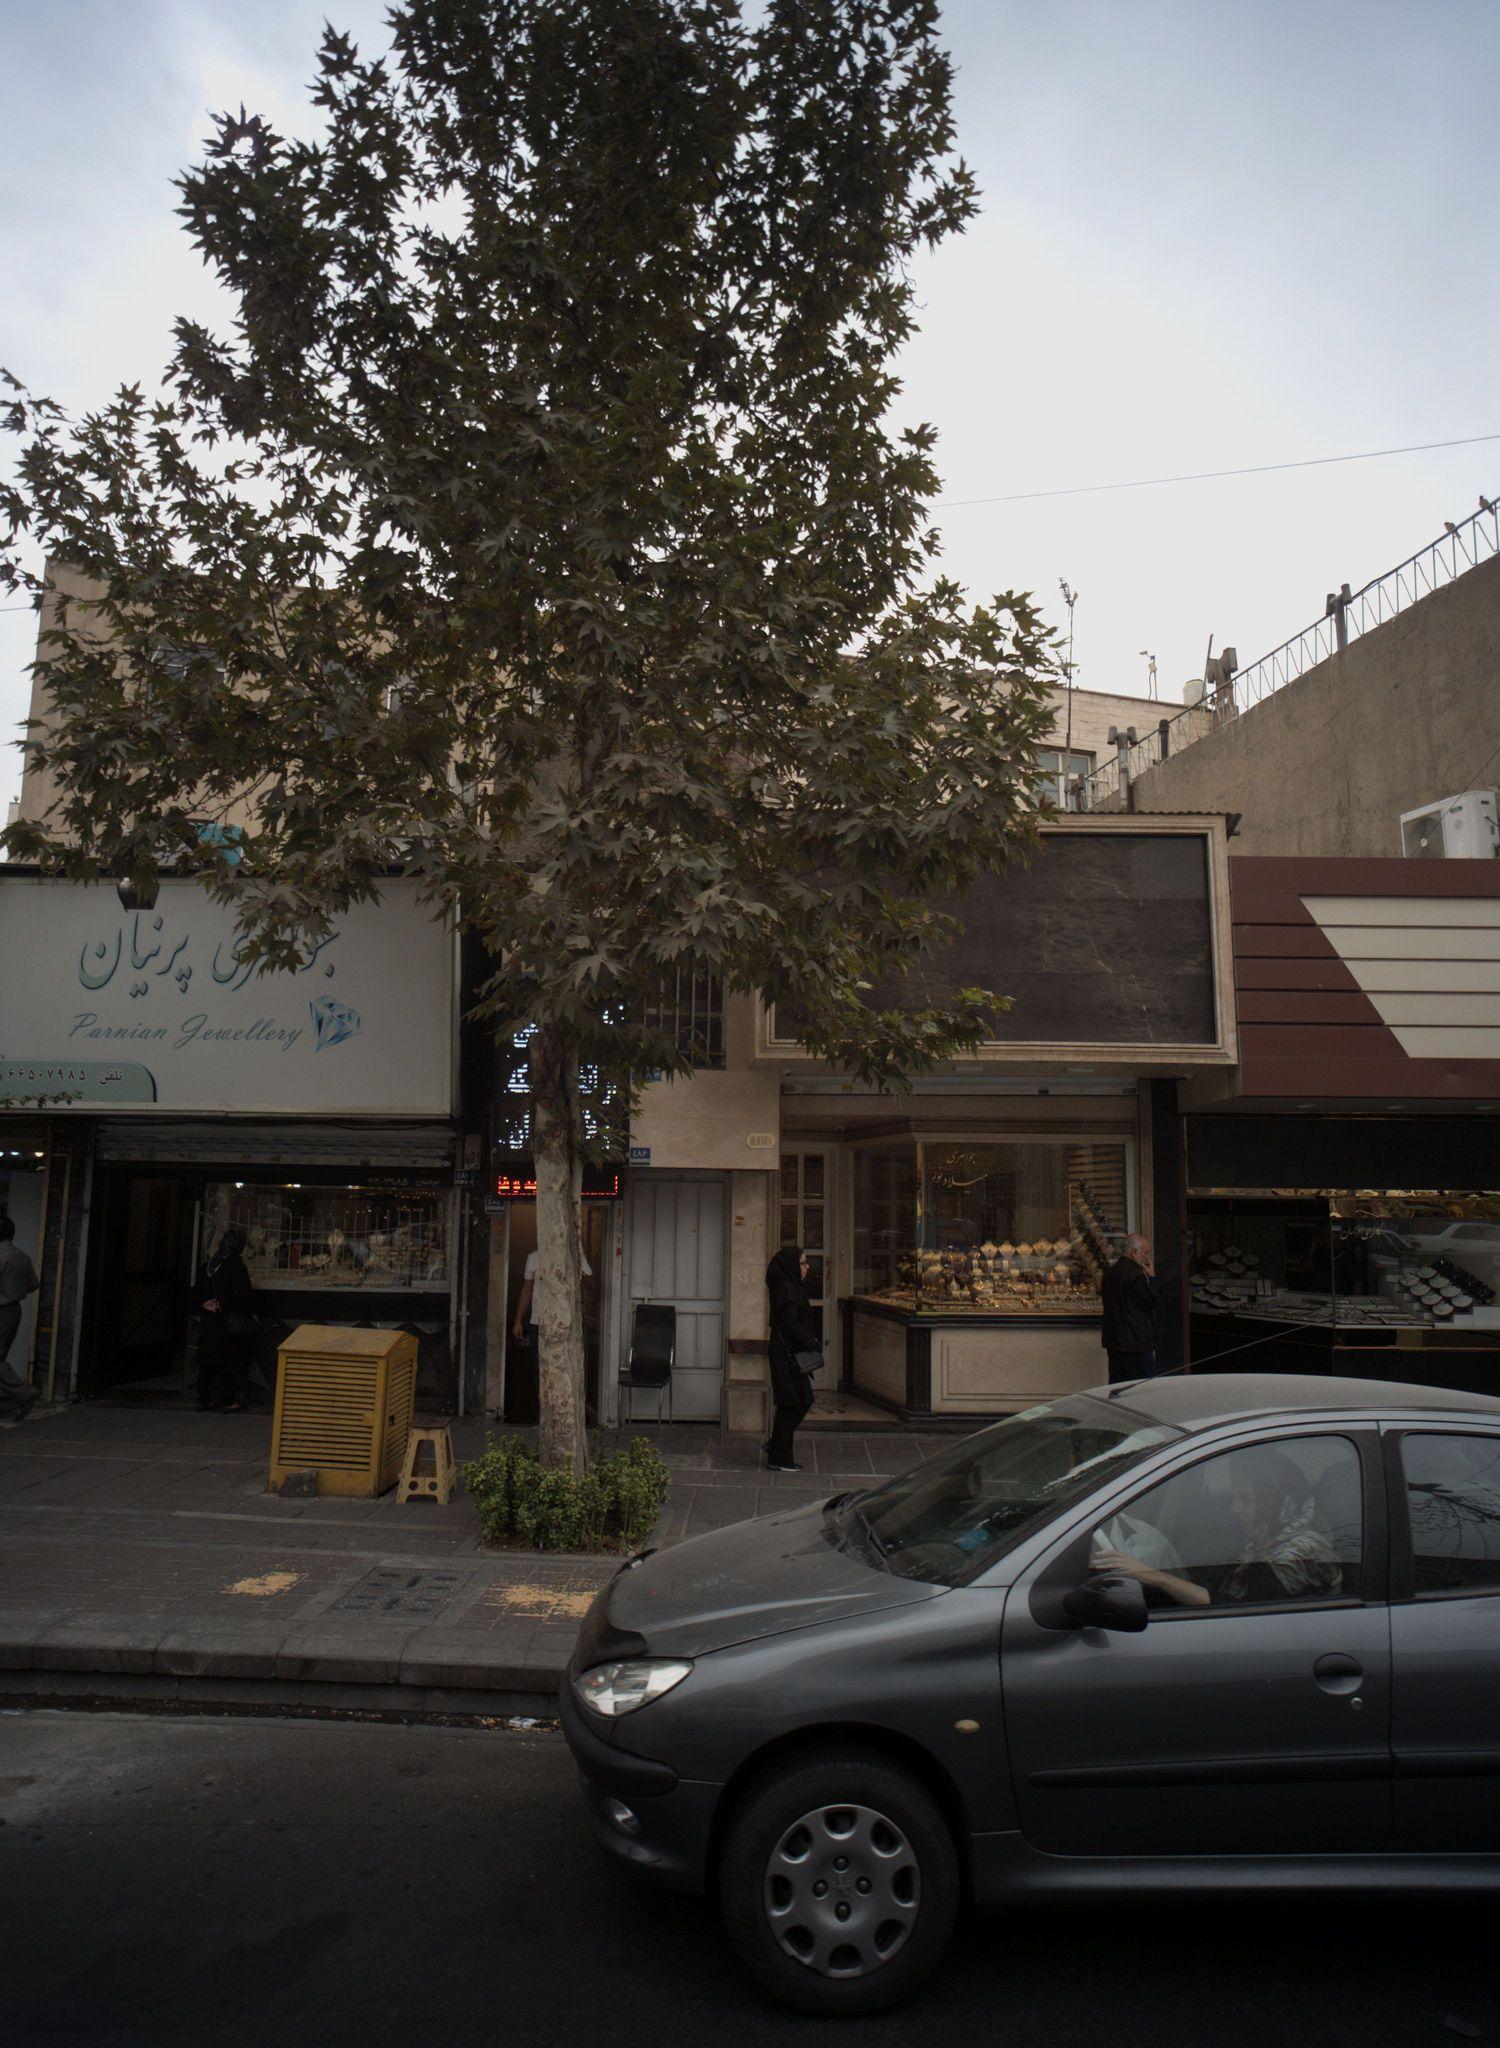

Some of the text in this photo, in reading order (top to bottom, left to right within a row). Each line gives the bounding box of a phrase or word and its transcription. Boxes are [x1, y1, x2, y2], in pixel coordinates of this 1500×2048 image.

[78, 911, 193, 998] پرنیان
[68, 1012, 304, 1052] Parnian Jewellery
[7, 1067, 87, 1081] ۶۶۵۰۷۹۸۵
[946, 1150, 976, 1166] جواهری
[943, 1172, 988, 1194] میلاد
